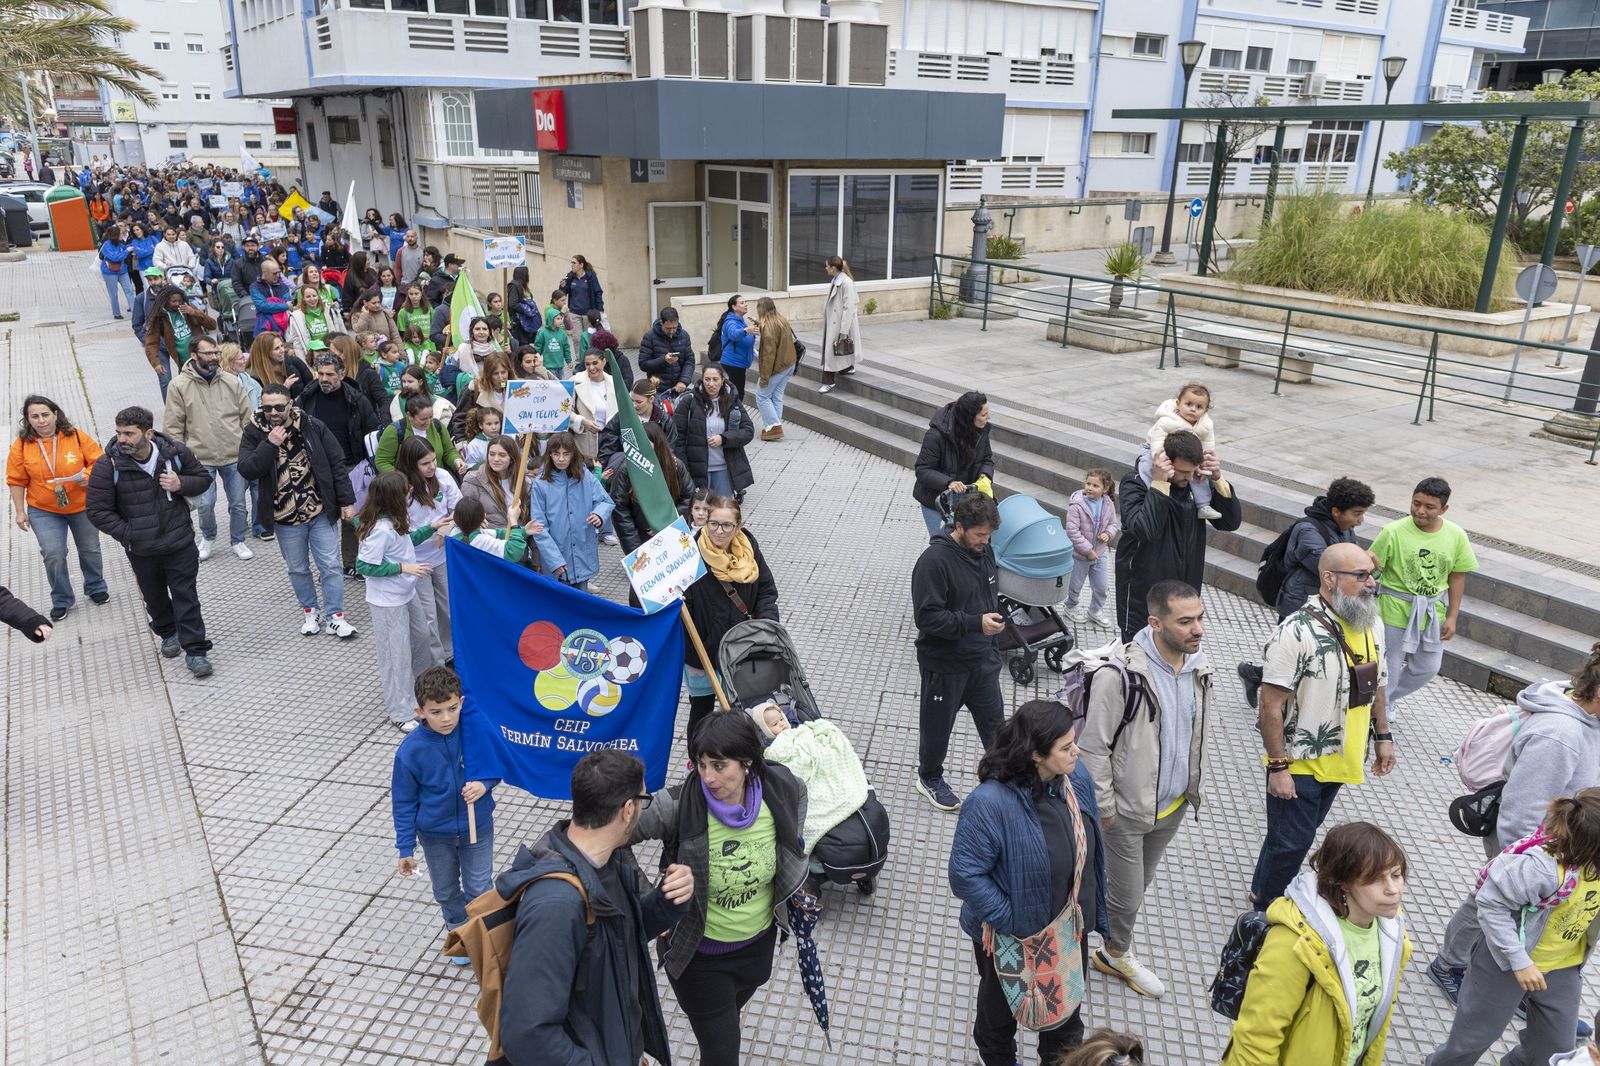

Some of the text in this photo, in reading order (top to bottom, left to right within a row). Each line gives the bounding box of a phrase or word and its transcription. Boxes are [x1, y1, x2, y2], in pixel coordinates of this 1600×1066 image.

[518, 409, 559, 420] SAN FELIPE
[628, 447, 655, 474] FELIPE
[655, 550, 669, 566] CEIP
[554, 718, 591, 734] CEIP
[500, 725, 552, 749] FERMÍN
